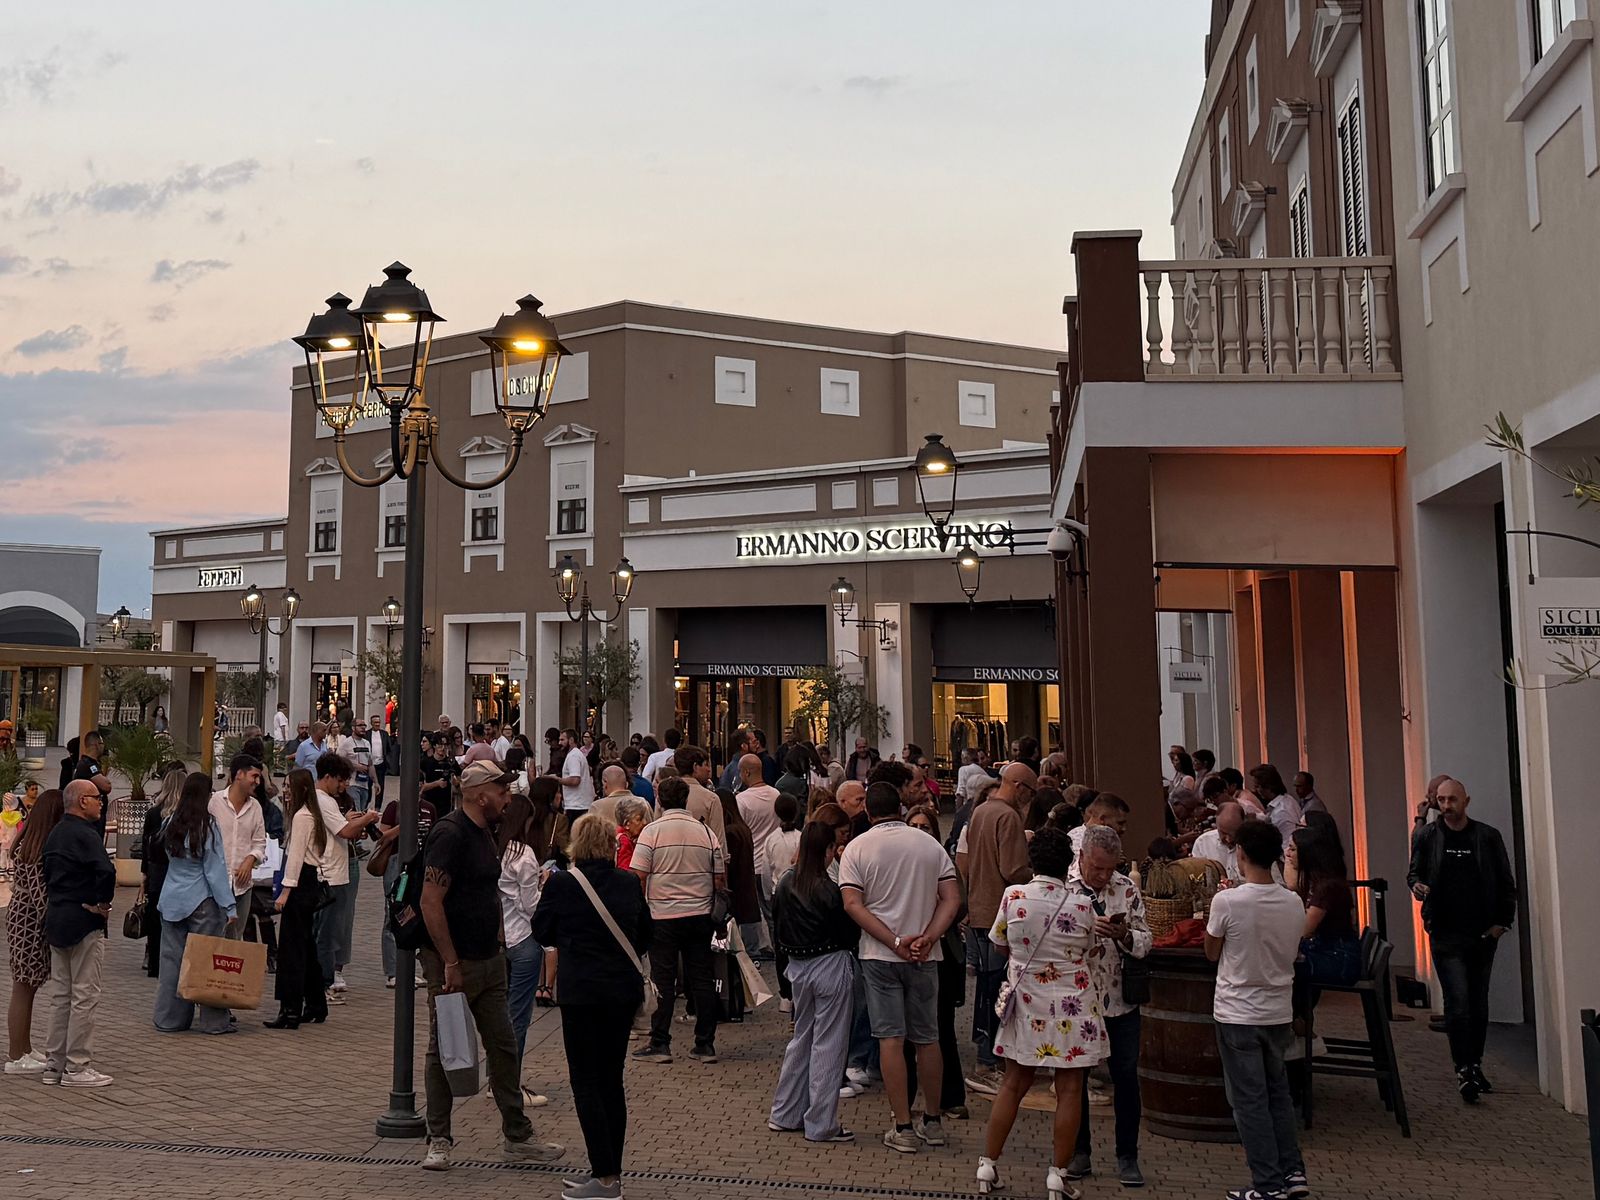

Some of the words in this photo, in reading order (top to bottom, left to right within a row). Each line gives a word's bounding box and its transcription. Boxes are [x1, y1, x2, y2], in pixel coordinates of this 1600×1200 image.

[503, 373, 552, 396] OSCHIO
[736, 530, 860, 557] ERMANNO
[866, 522, 1009, 551] SCERVINO
[198, 566, 242, 587] Ferrari
[1545, 626, 1588, 635] OUTLET
[707, 664, 760, 676] ERMANNO
[973, 667, 1043, 680] ERMANNO
